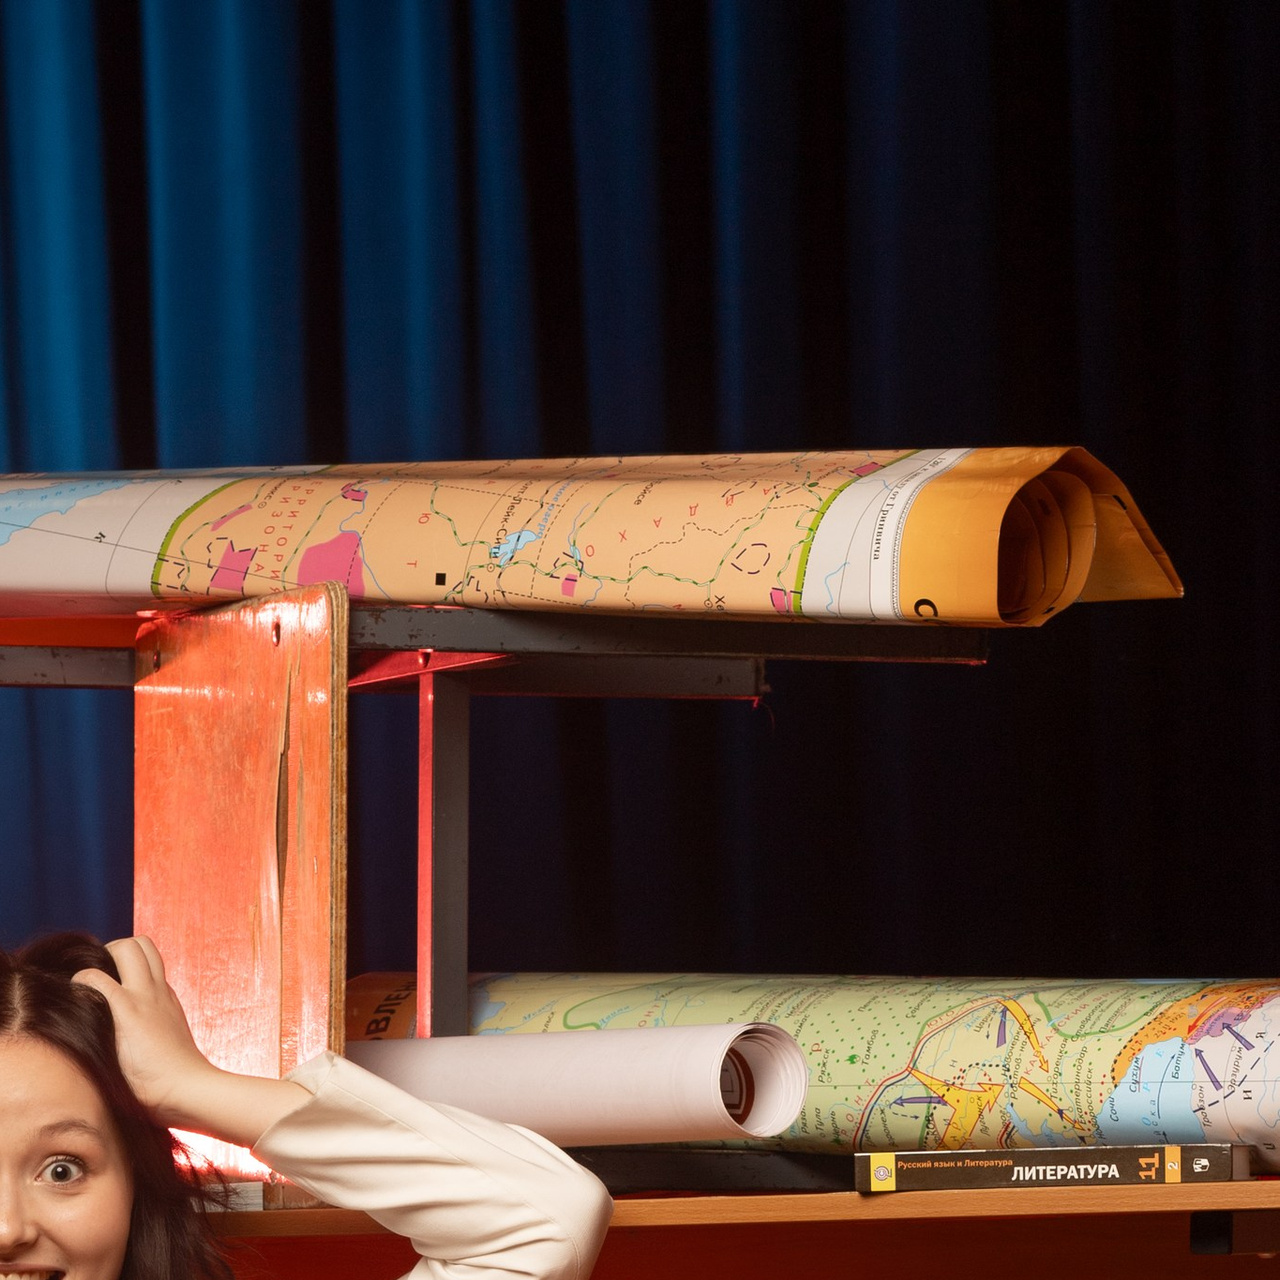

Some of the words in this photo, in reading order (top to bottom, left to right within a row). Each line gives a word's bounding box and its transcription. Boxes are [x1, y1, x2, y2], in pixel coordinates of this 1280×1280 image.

[536, 503, 557, 540] озеро
[872, 503, 894, 560] Гринвича
[861, 1028, 880, 1066] Тамбов
[1010, 1016, 1041, 1100] Ростов-на-Дону
[1171, 1042, 1187, 1080] Батум
[817, 1048, 830, 1084] Ряжск
[1049, 1037, 1069, 1101] Тихорецкая
[1129, 1056, 1141, 1093] Сухум
[1227, 1046, 1244, 1092] Эрзурум
[1075, 1045, 1088, 1126] Екатеринодар
[1085, 1067, 1106, 1141] Новороссийск
[815, 1107, 823, 1132] Тула
[1109, 1097, 1119, 1122] Сочи
[897, 1159, 933, 1170] Русский
[933, 1160, 954, 1170] язык
[955, 1160, 962, 1168] и
[963, 1157, 1014, 1169] Литература
[1011, 1164, 1120, 1182] ЛИТЕРАТУРА
[1138, 1152, 1160, 1181] 11
[1167, 1162, 1179, 1170] 2
